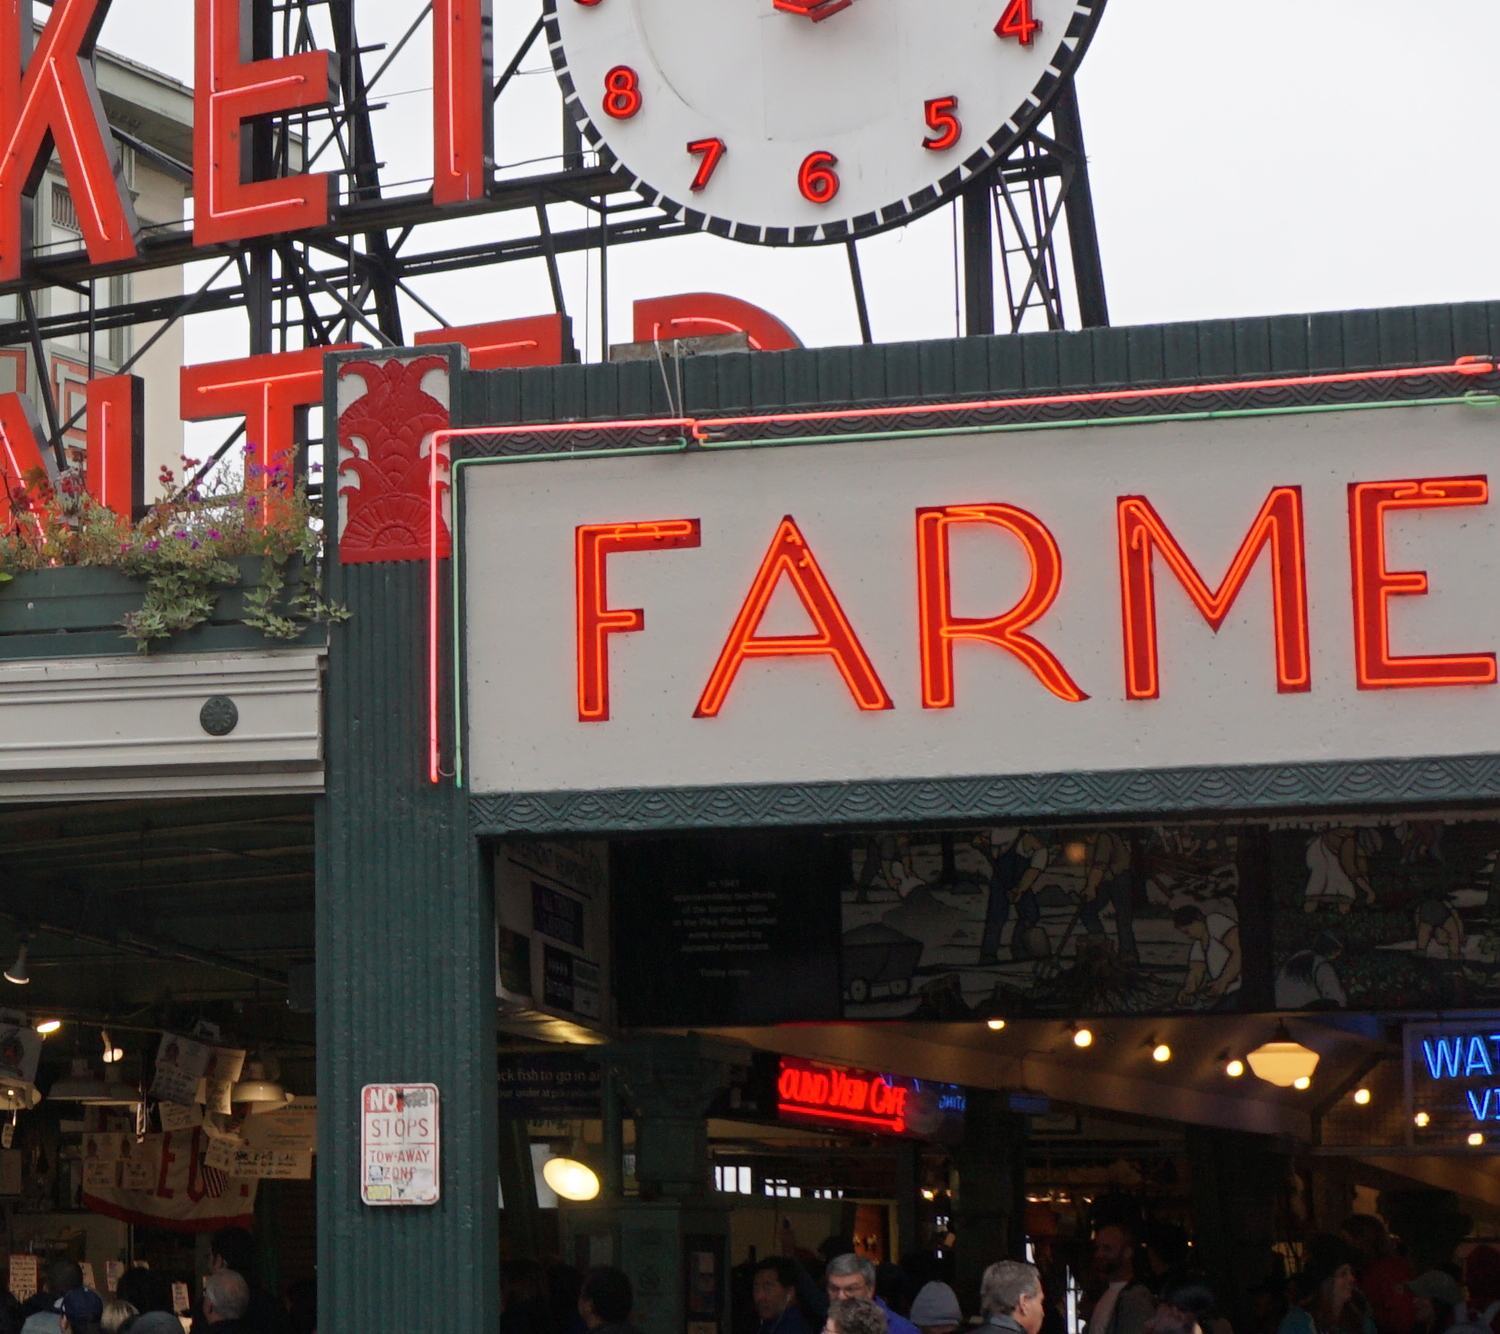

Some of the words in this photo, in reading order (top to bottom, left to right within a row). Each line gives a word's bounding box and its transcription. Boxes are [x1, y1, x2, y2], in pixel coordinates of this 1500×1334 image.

[601, 66, 643, 121] 8
[923, 97, 963, 152] 5
[686, 137, 726, 192] 7
[797, 151, 840, 204] 6
[370, 1088, 398, 1112] NO
[778, 1067, 830, 1106] OUND
[371, 1118, 429, 1138] STOPS
[369, 1149, 431, 1164] TOW-AWAY
